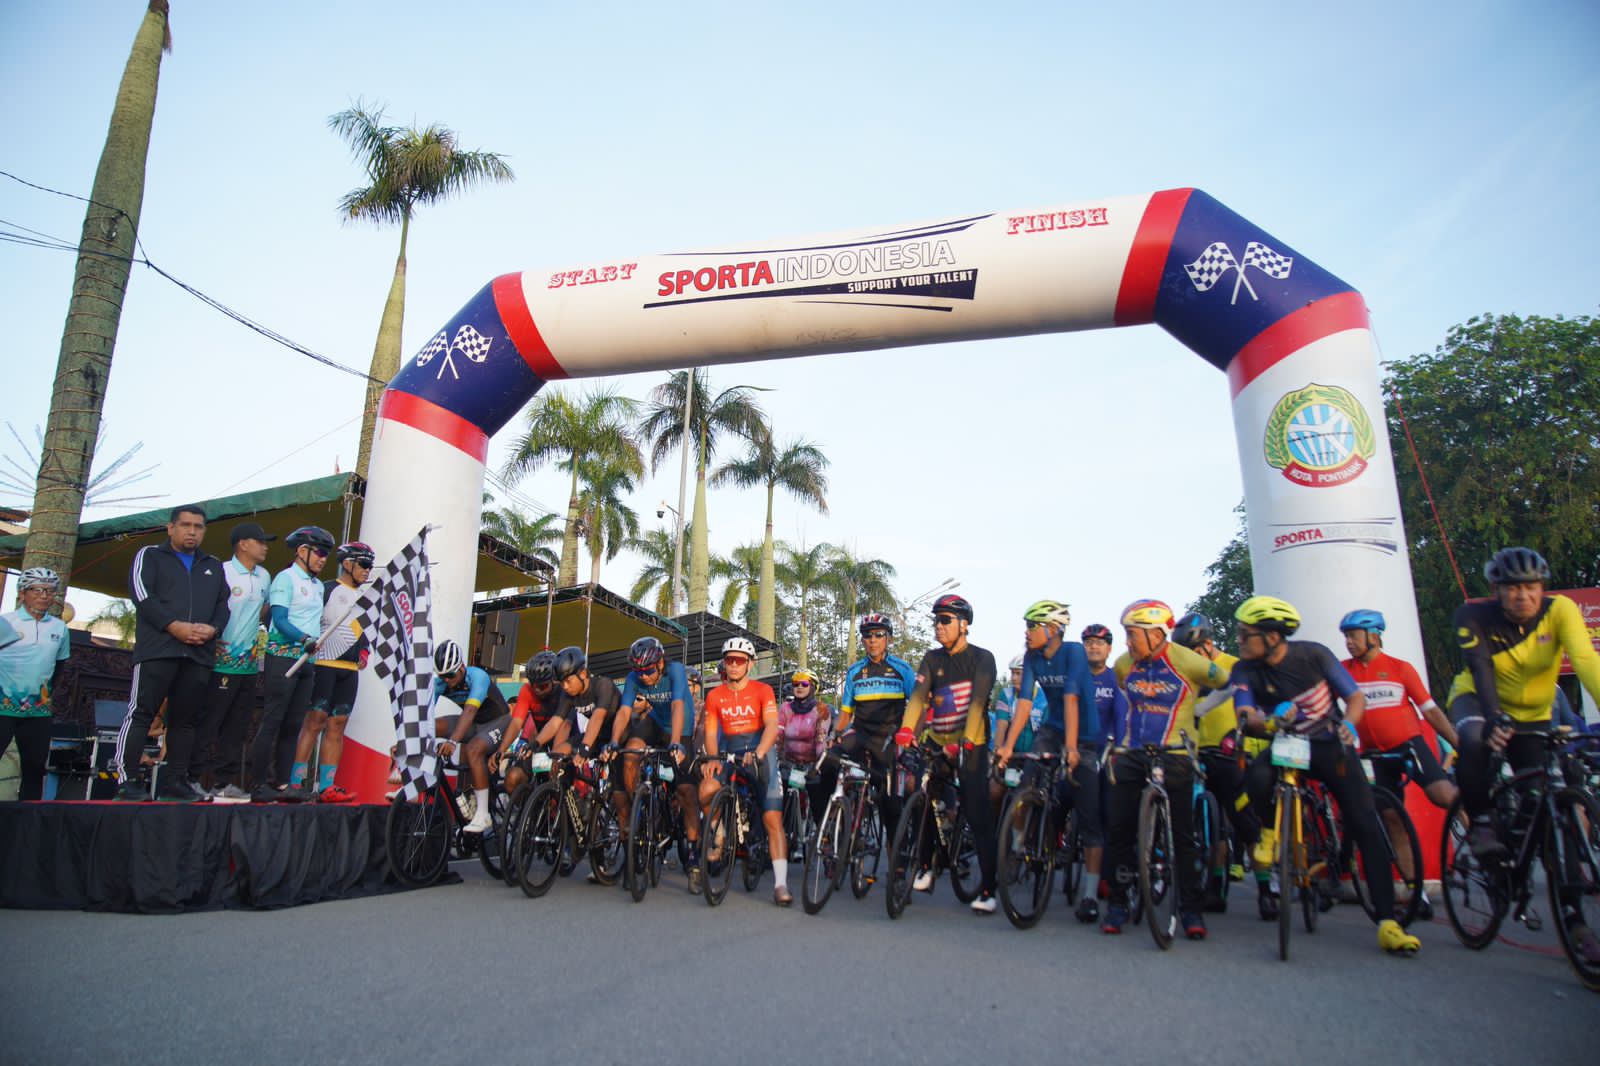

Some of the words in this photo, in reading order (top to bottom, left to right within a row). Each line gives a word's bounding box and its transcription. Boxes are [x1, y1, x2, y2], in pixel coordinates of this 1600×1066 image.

[1007, 207, 1108, 235] FINISH
[547, 263, 638, 289] START
[847, 278, 897, 293] SUPPORT
[900, 274, 931, 288] YOUR
[934, 270, 974, 284] TALENT
[1274, 528, 1324, 547] SPORTA
